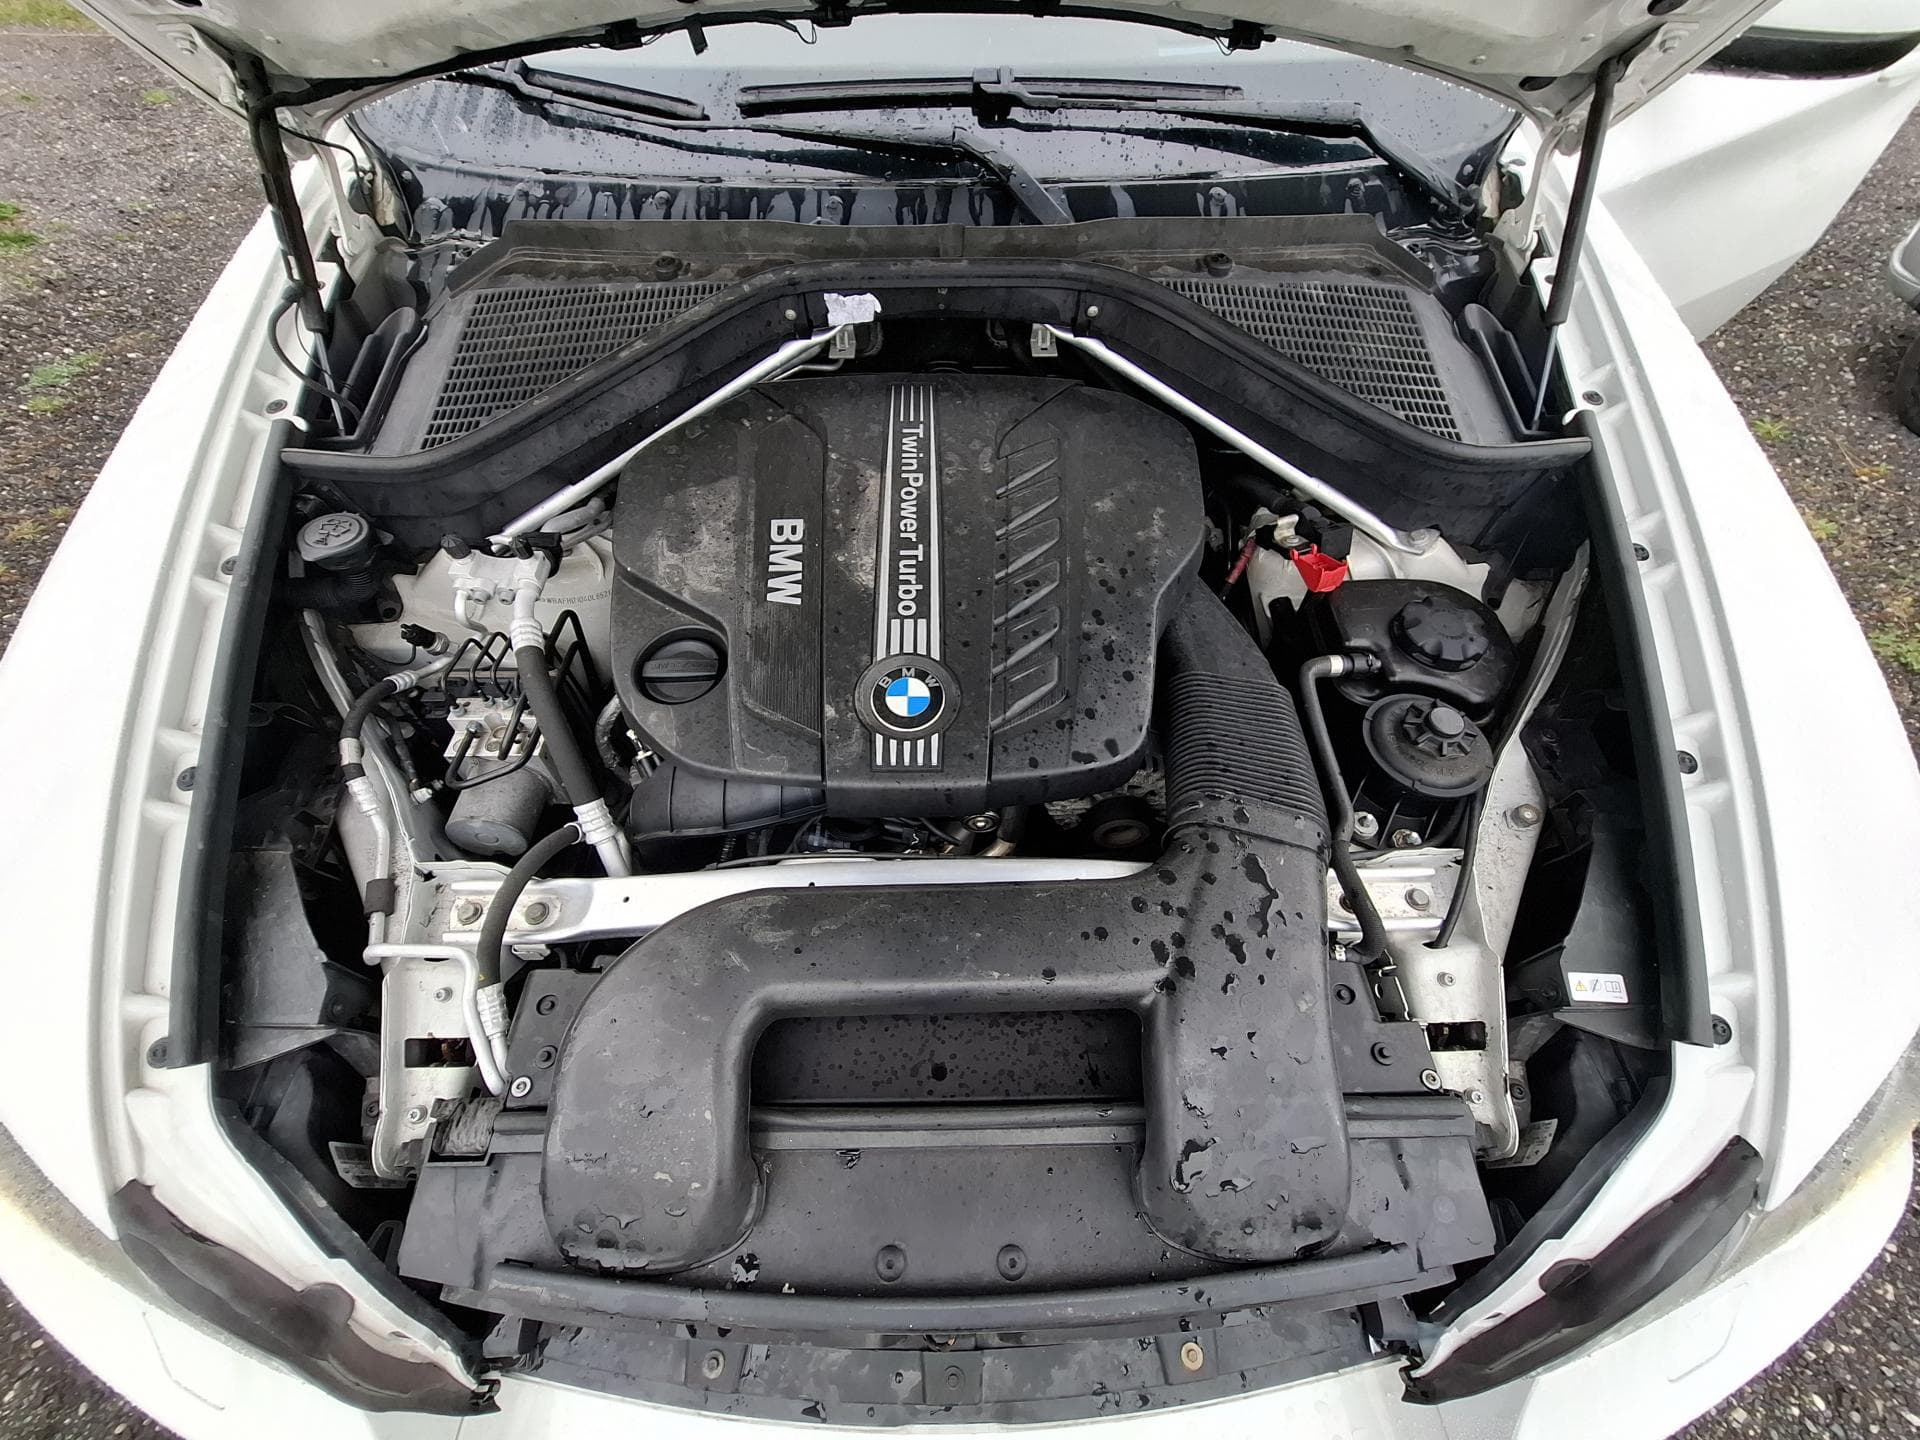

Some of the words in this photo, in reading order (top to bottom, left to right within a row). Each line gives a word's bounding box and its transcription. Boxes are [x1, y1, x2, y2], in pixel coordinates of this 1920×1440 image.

[900, 424, 924, 541] TwinPower
[767, 518, 804, 605] BMW
[898, 544, 924, 616] Turbo
[878, 667, 940, 689] BMW
